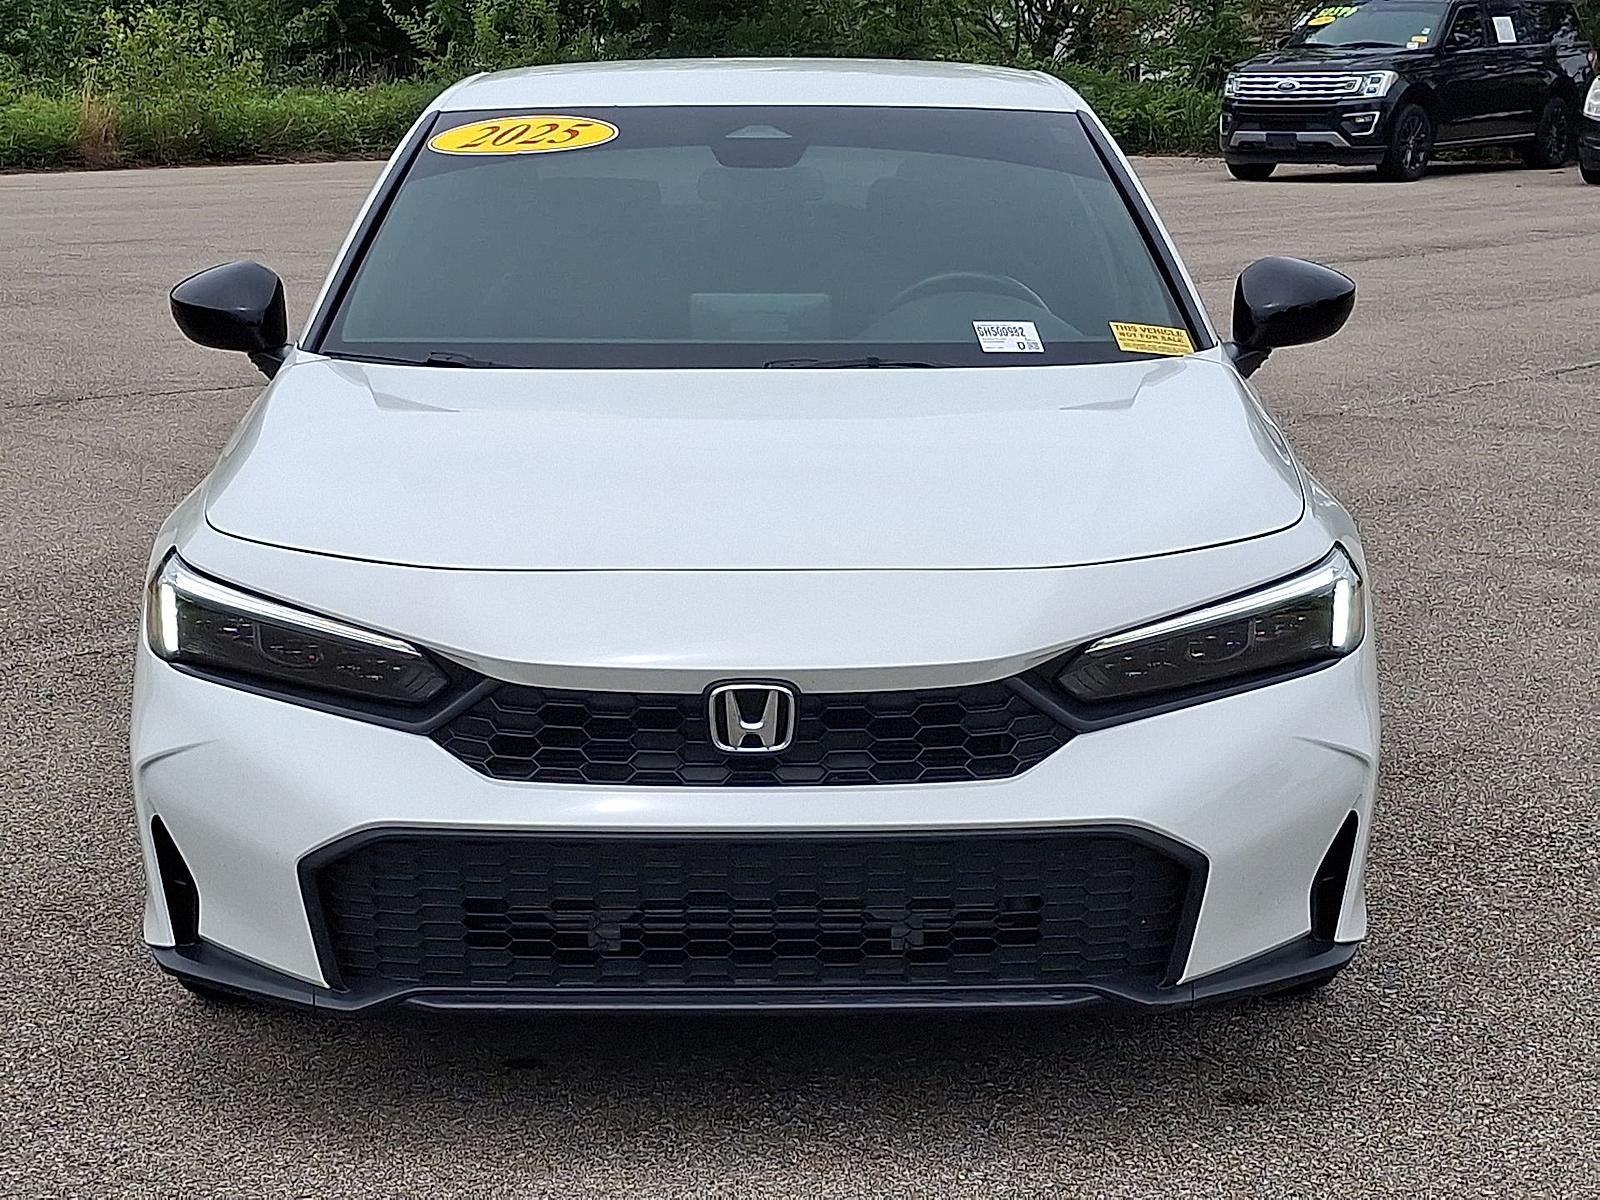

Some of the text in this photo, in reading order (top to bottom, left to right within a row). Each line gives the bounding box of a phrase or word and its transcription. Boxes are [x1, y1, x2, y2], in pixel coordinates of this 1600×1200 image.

[456, 123, 594, 149] 2025
[1113, 324, 1185, 338] THIS VEHICLE
[1161, 335, 1185, 344] SALE
